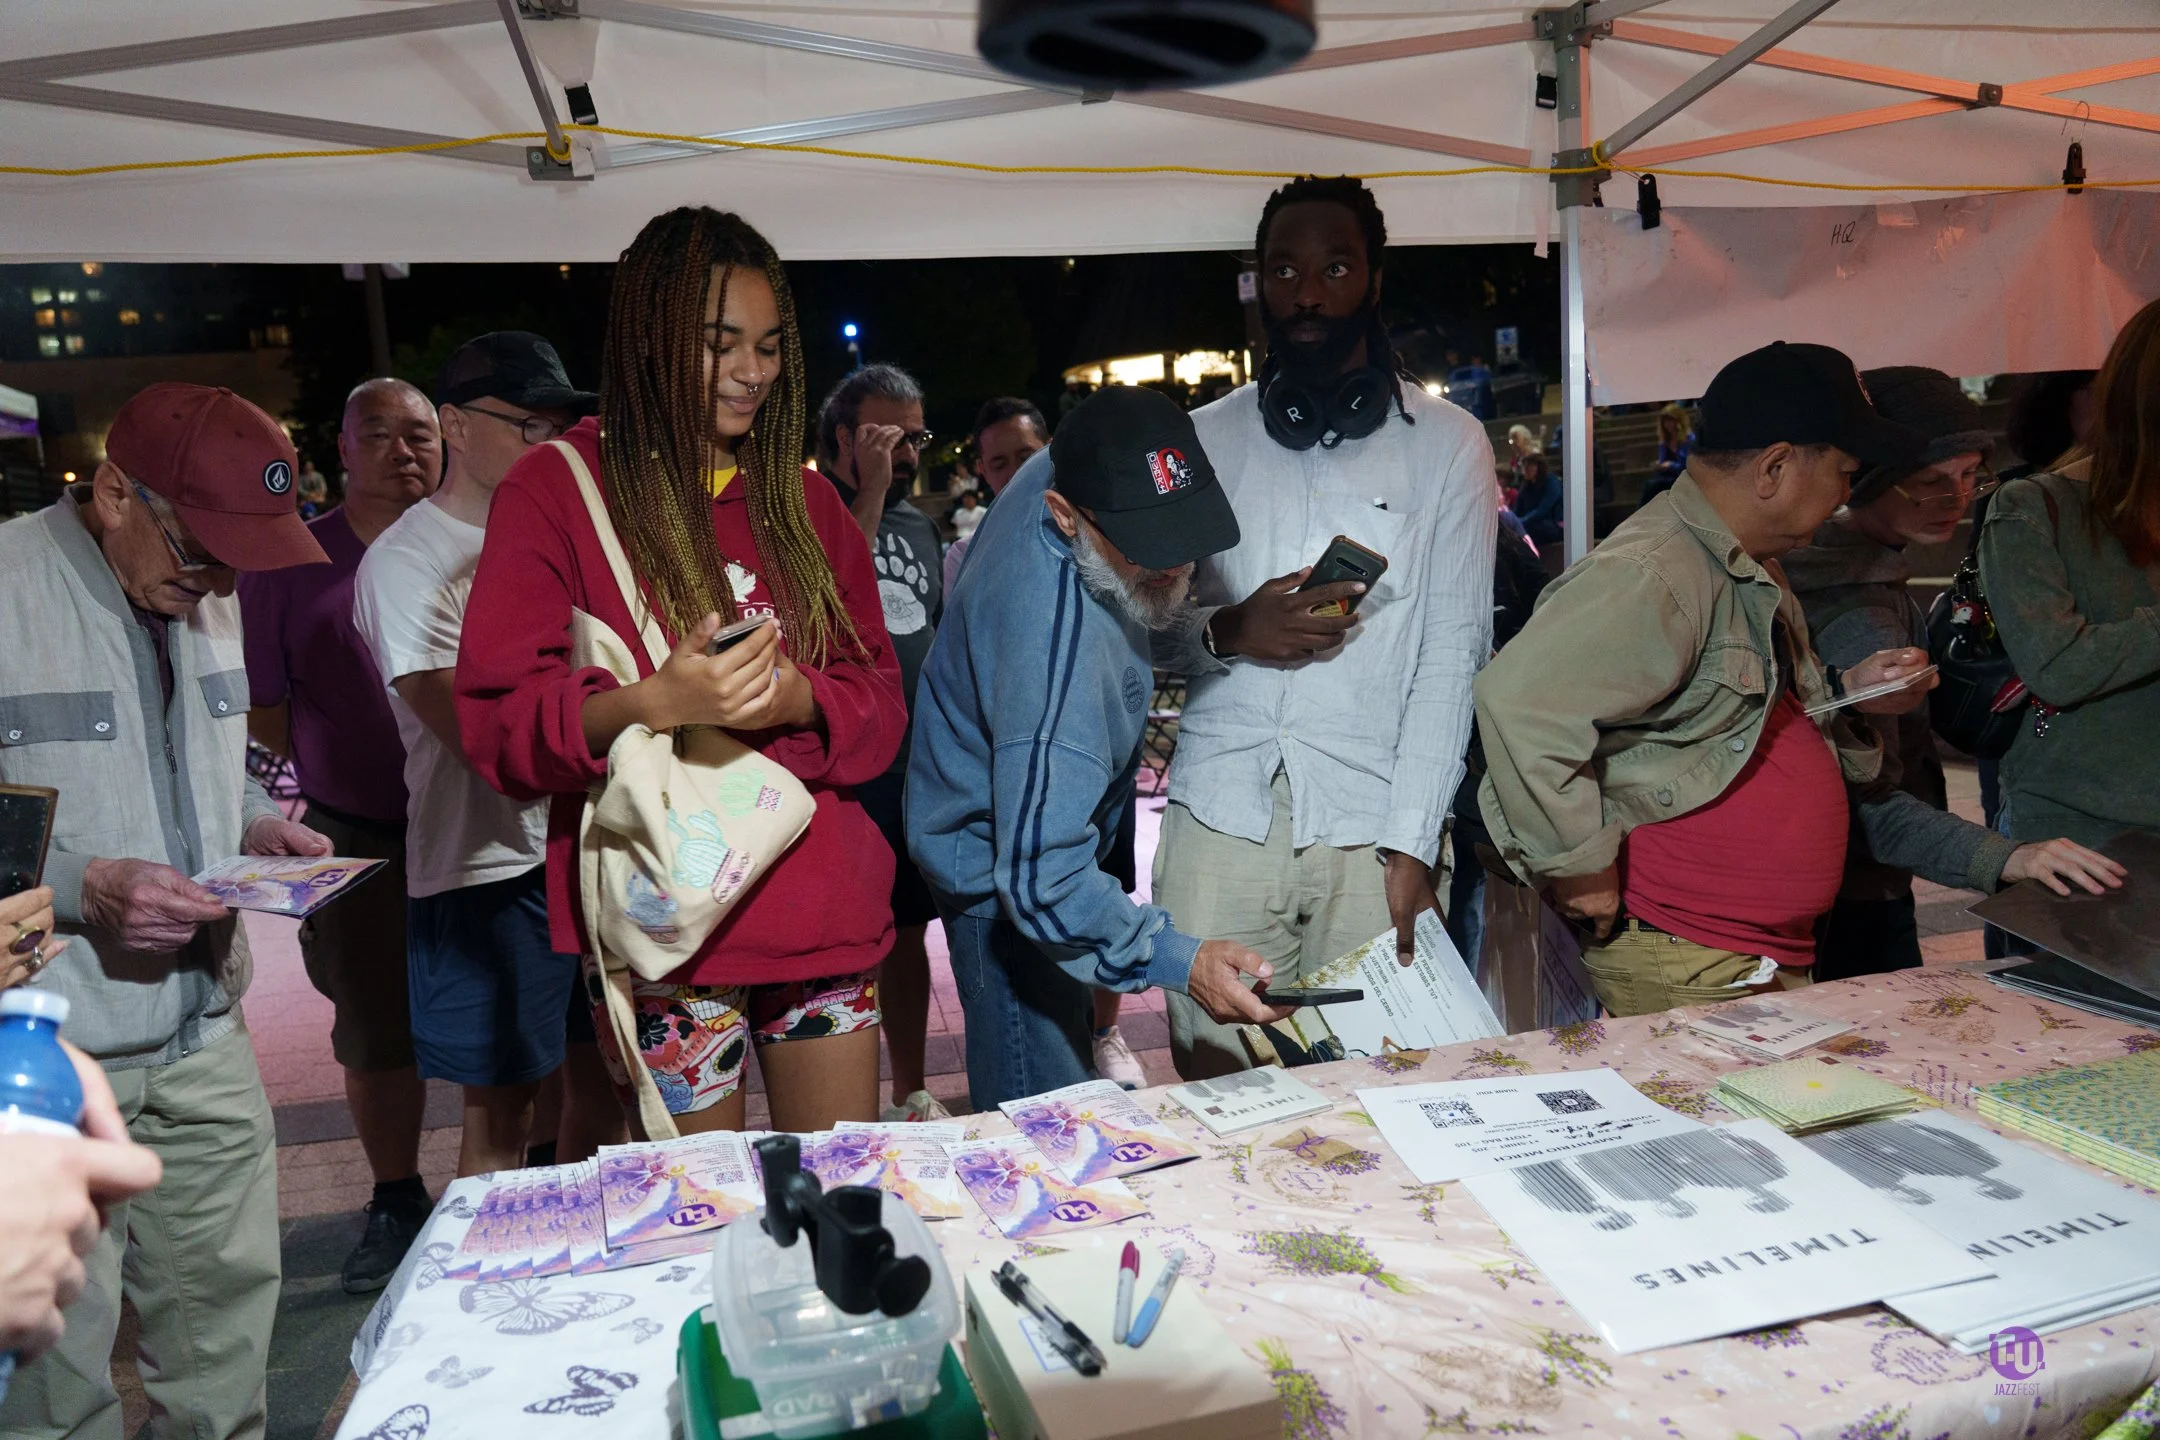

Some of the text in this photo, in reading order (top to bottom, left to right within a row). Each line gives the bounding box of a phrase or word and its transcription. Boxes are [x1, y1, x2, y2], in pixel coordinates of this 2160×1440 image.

[1286, 405, 1304, 423] R
[1350, 395, 1363, 410] L
[1369, 954, 1390, 985] JUSTINIAN
[1413, 961, 1431, 988] ESTABAS
[1358, 960, 1394, 1018] CALZADA DEL CERRO
[1766, 1021, 1828, 1045] TIMELINES
[1493, 1088, 1519, 1096] THANK
[1220, 1093, 1307, 1120] TIMELINES
[1492, 1134, 1623, 1163] AMPHITRIO MERCH
[1631, 1227, 1879, 1290] TIMELINES
